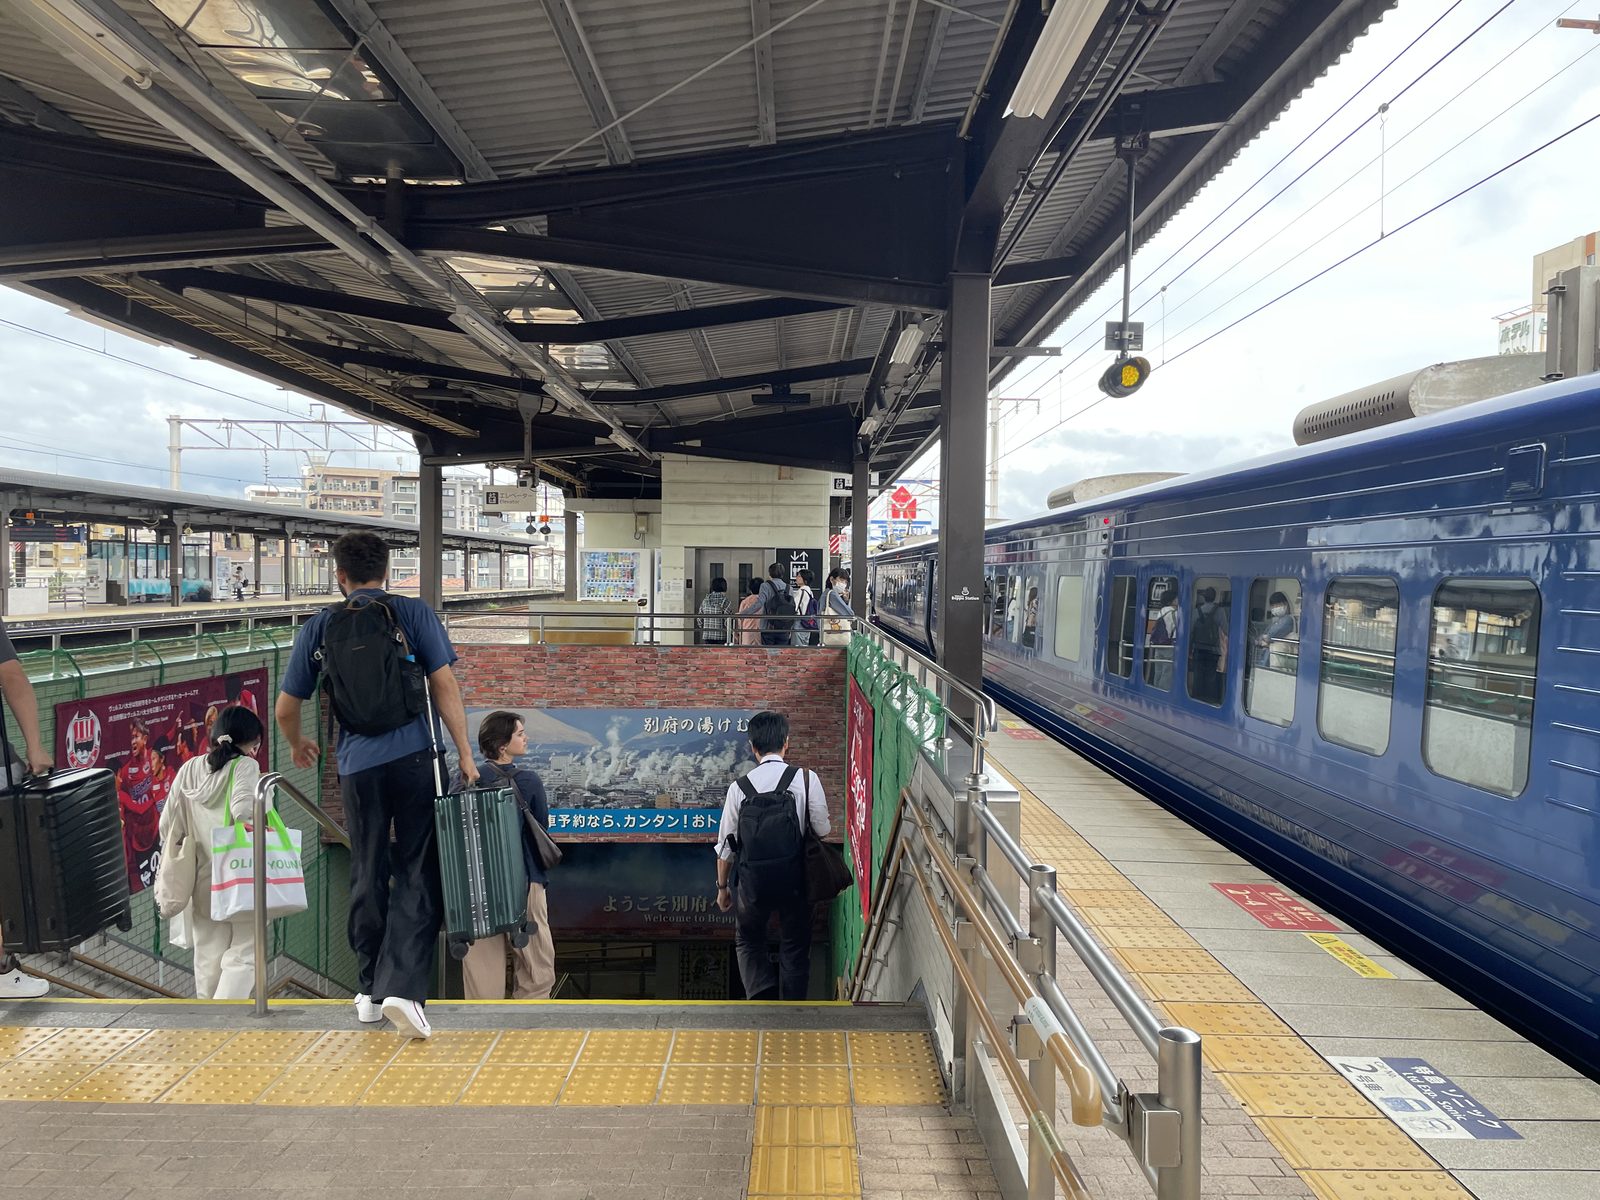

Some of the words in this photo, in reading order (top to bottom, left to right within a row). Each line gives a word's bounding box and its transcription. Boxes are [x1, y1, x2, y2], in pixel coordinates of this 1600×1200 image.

[643, 715, 750, 735] 別府の湯けむ
[548, 813, 721, 829] 車予約なら、カンタン！おト
[1294, 825, 1350, 867] COMPANY
[229, 857, 252, 870] OLI
[267, 859, 302, 870] YOUN
[644, 913, 692, 923] Welcome
[694, 914, 706, 923] to
[708, 914, 737, 925] Bepp
[1402, 1071, 1422, 1086] Ltd
[1418, 1083, 1439, 1100] Exp.
[1437, 1099, 1468, 1121] Sonic
[1411, 1065, 1448, 1085] 特急
[1441, 1088, 1504, 1130] ソニック
